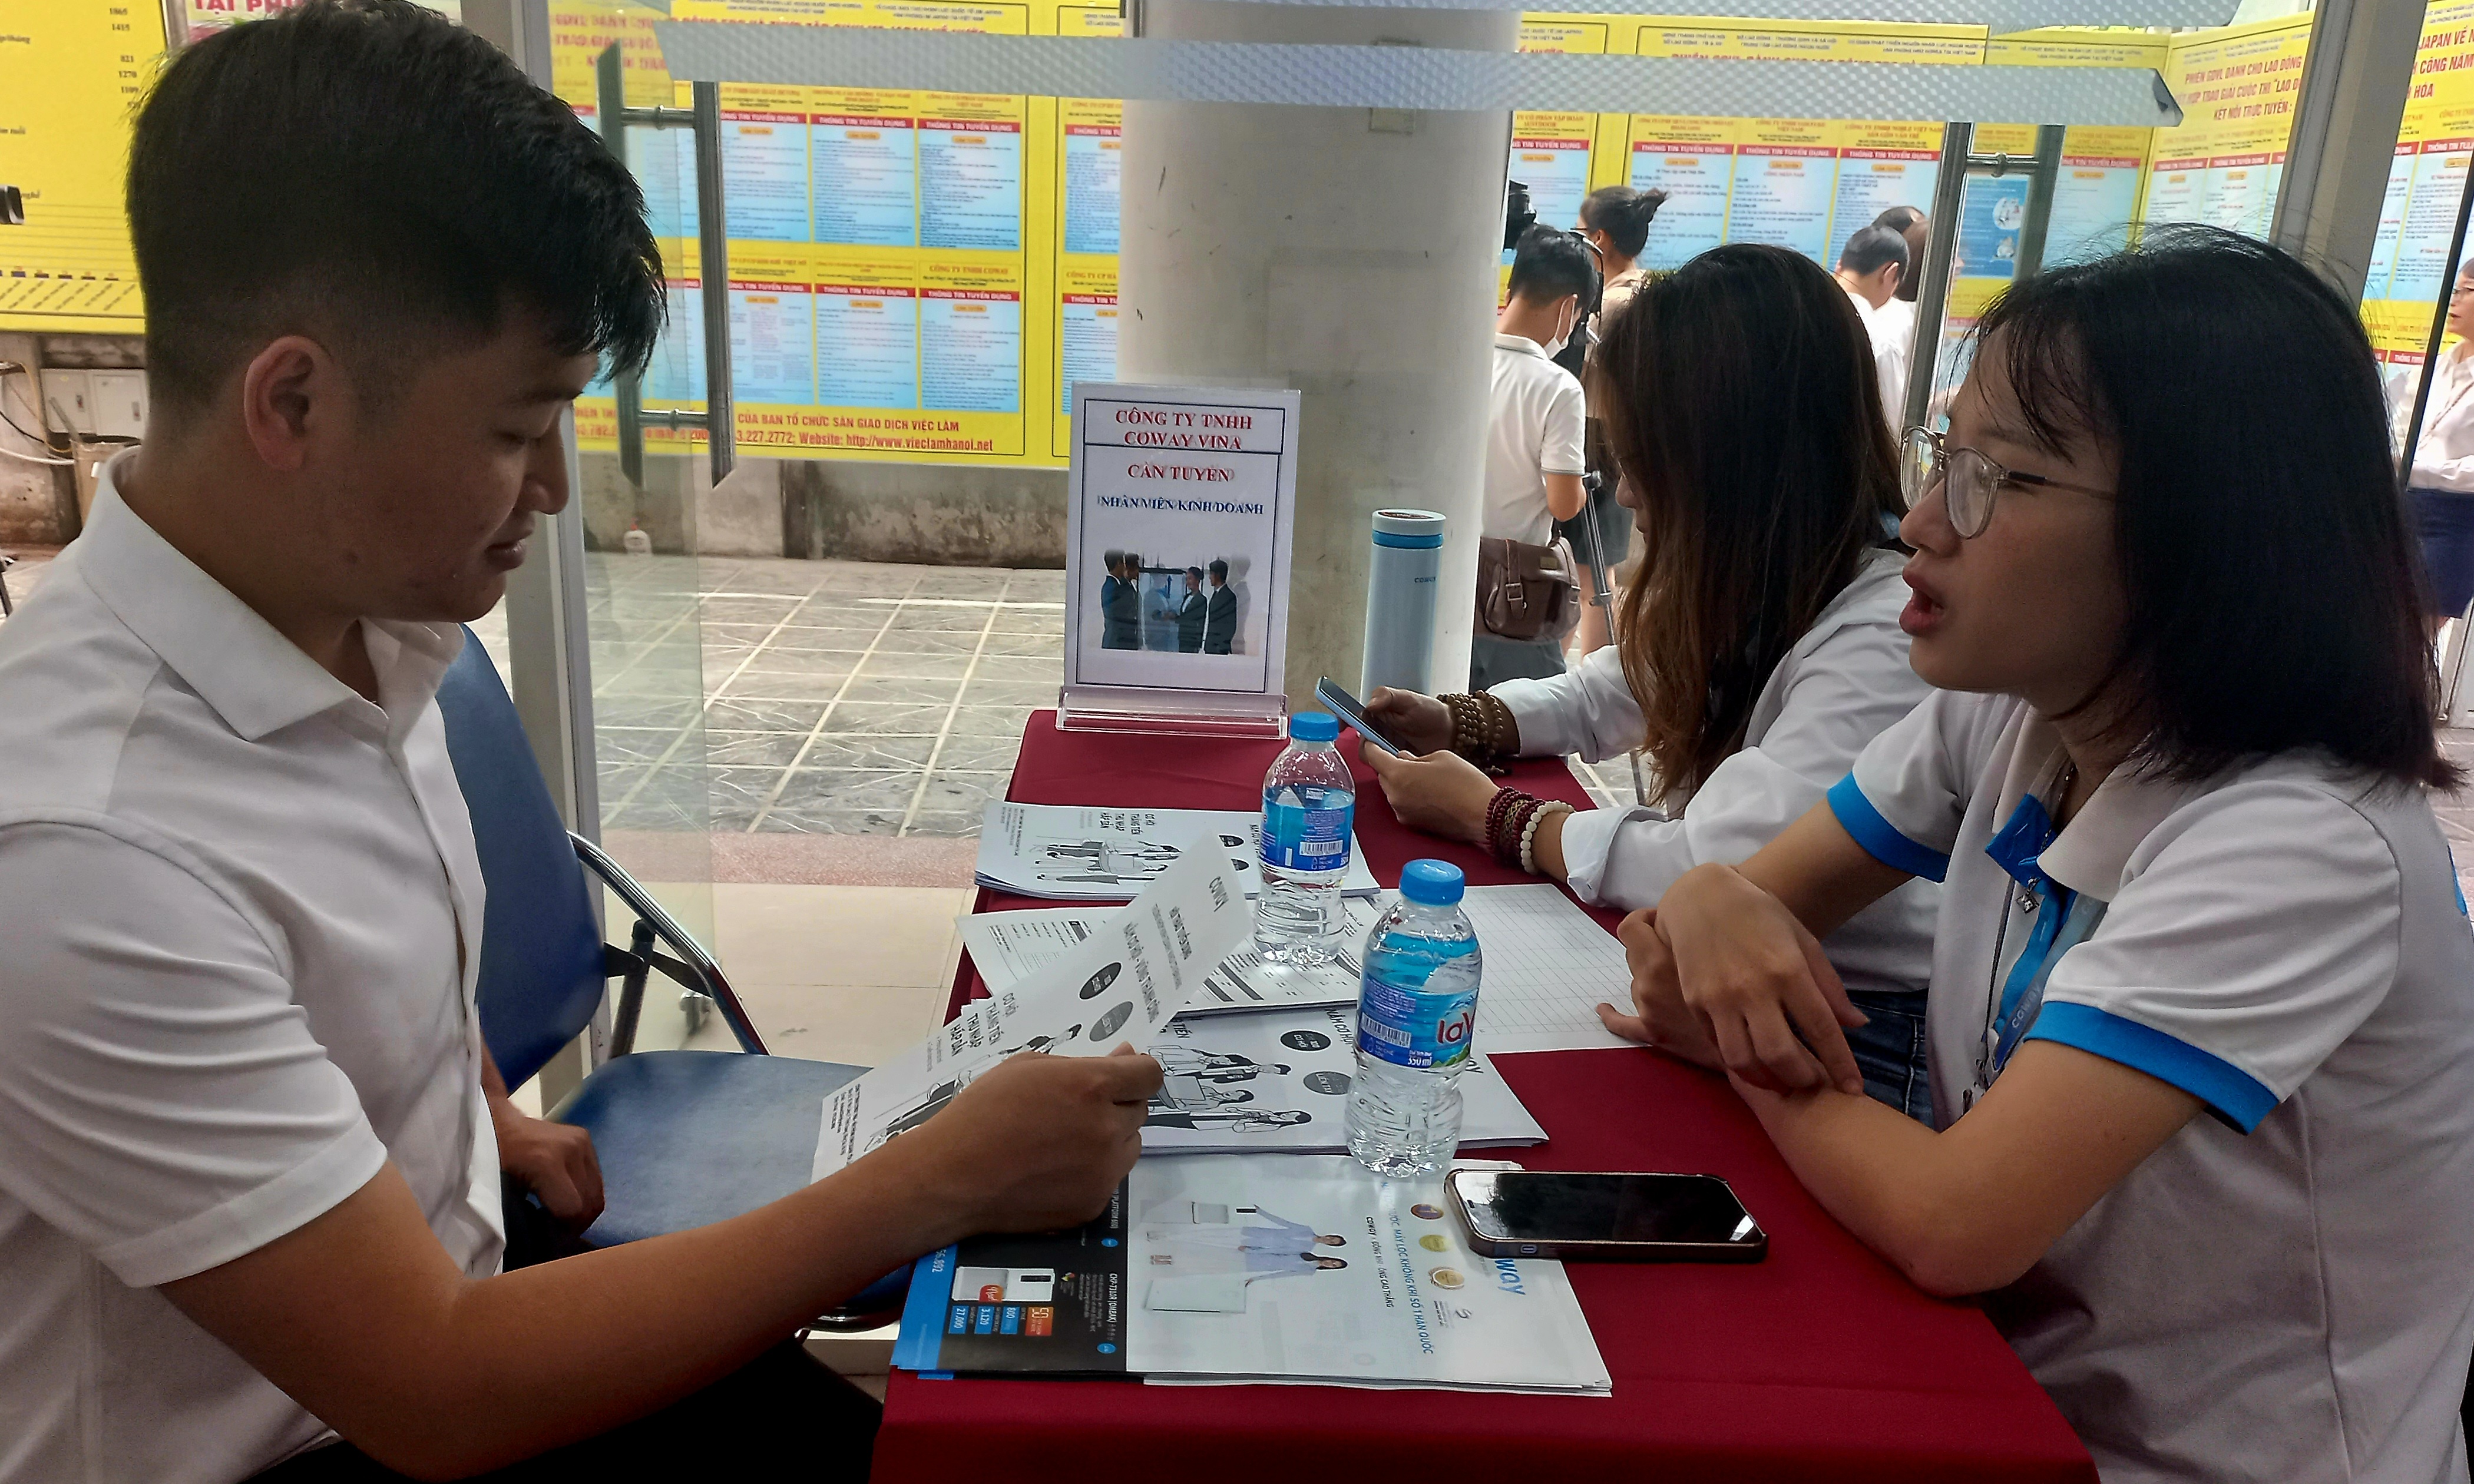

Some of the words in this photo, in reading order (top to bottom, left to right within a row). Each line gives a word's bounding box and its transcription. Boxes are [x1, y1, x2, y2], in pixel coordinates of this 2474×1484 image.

[2247, 61, 2264, 76] CHO
[2264, 59, 2279, 74] LAO
[2279, 55, 2303, 73] ĐỘNG
[2419, 57, 2446, 74] CÔNG
[2448, 52, 2474, 70] NĂM
[2413, 81, 2434, 99] HÓA
[762, 413, 783, 425] BAN
[802, 413, 829, 426] CHỨC
[858, 418, 881, 429] GIAO
[884, 419, 909, 432] DỊCH
[912, 419, 935, 432] VIỆC
[1115, 406, 1167, 426] CÔNG
[1172, 412, 1195, 427] TY
[1201, 413, 1253, 430] TNHH
[799, 432, 843, 446] Website:
[1124, 430, 1193, 448] COWAY
[1198, 433, 1242, 450] VINA
[1099, 495, 1139, 509] NHÂN
[1141, 496, 1175, 510] VIÊN
[1178, 499, 1212, 512] KINH
[1215, 501, 1264, 515] DOANH
[967, 1012, 980, 1032] THU
[1422, 1056, 1433, 1066] ml
[1380, 1279, 1390, 1290] CAO
[1494, 1259, 1526, 1296] way
[1400, 1258, 1417, 1284] KHÔNG
[1413, 1314, 1427, 1331] HÀN
[954, 1307, 966, 1329] 27.000
[979, 1307, 990, 1325] 3.120
[1006, 1307, 1016, 1319] 800
